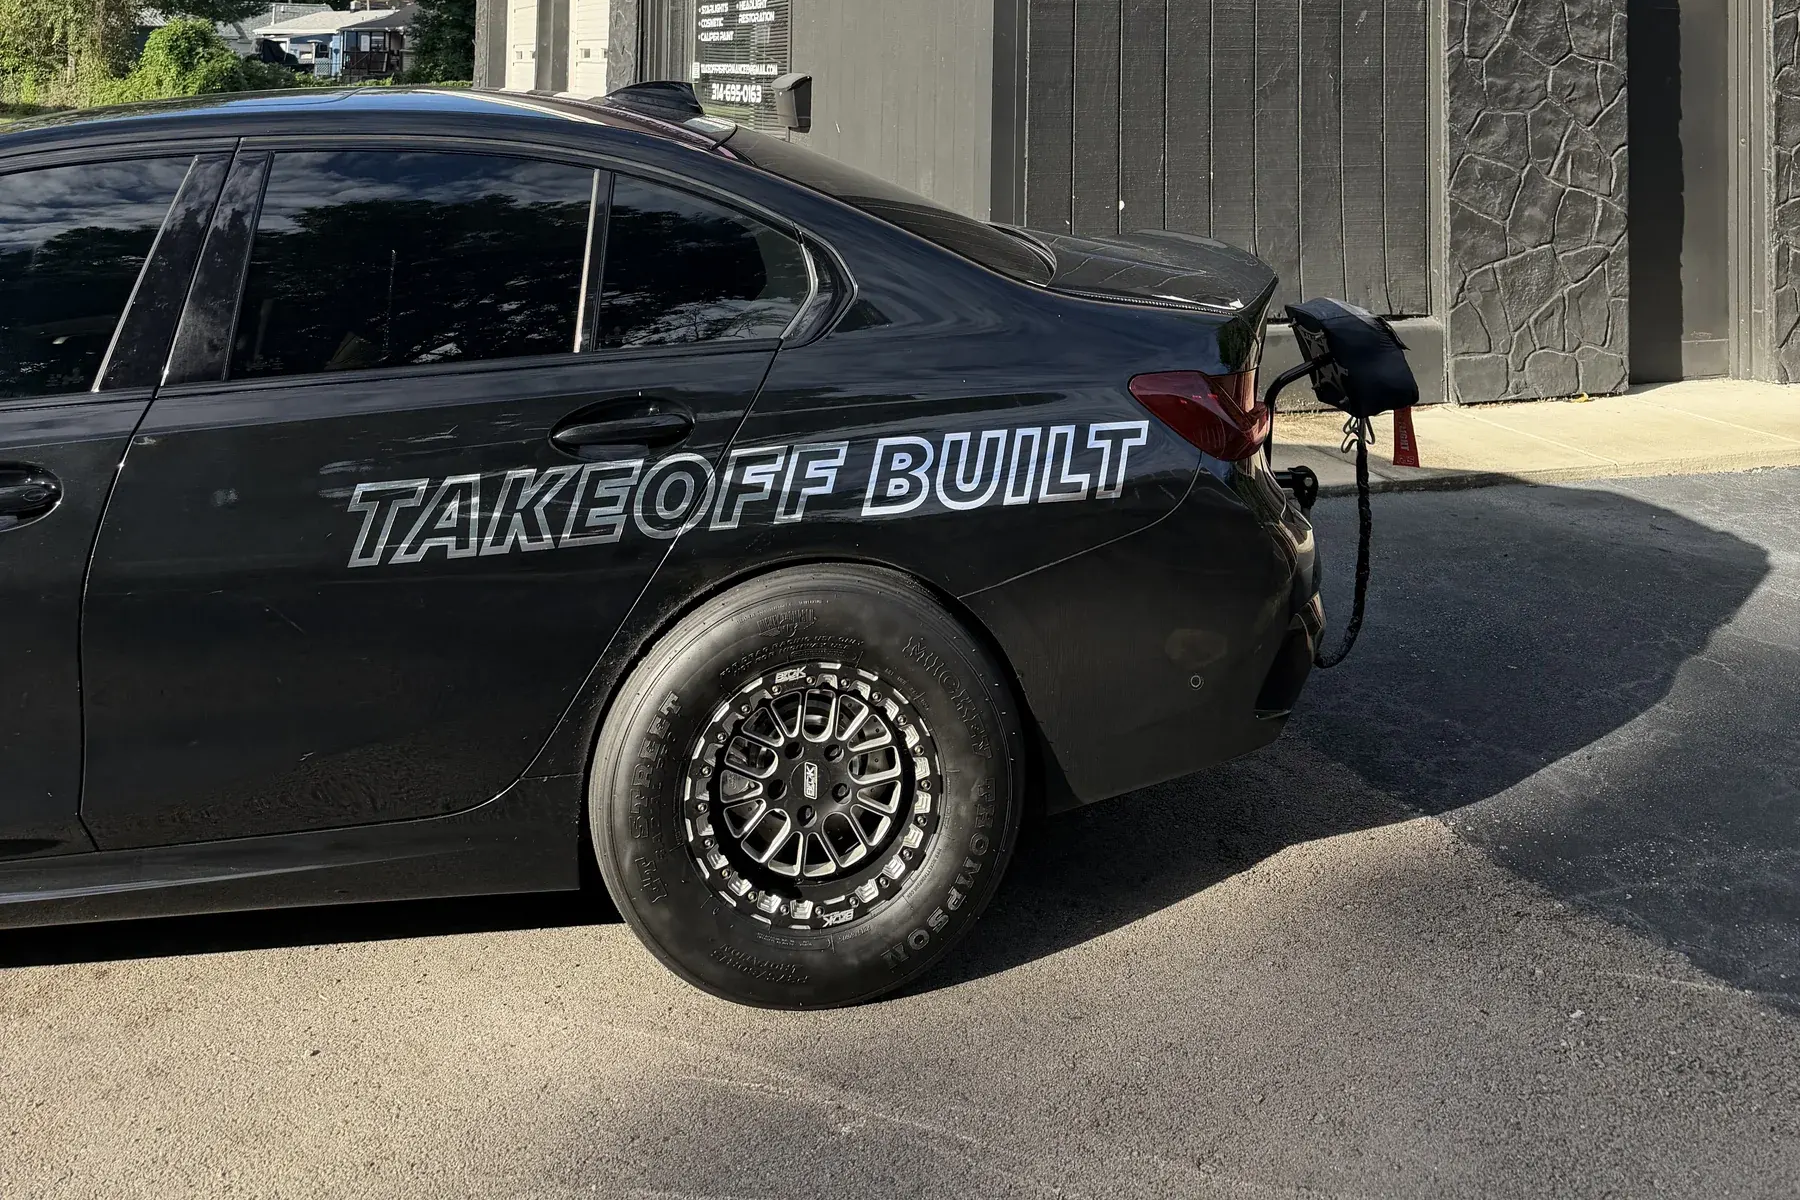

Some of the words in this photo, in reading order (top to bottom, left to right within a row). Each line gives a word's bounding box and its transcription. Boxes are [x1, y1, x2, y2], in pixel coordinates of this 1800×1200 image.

[739, 11, 775, 23] RESTORATION
[711, 83, 762, 103] 314-695-0163
[347, 440, 849, 568] TAKEOFF
[860, 419, 1150, 517] BUILT
[628, 690, 682, 840] STREET
[902, 636, 992, 760] MICKEY
[881, 777, 996, 972] THOMPSON
